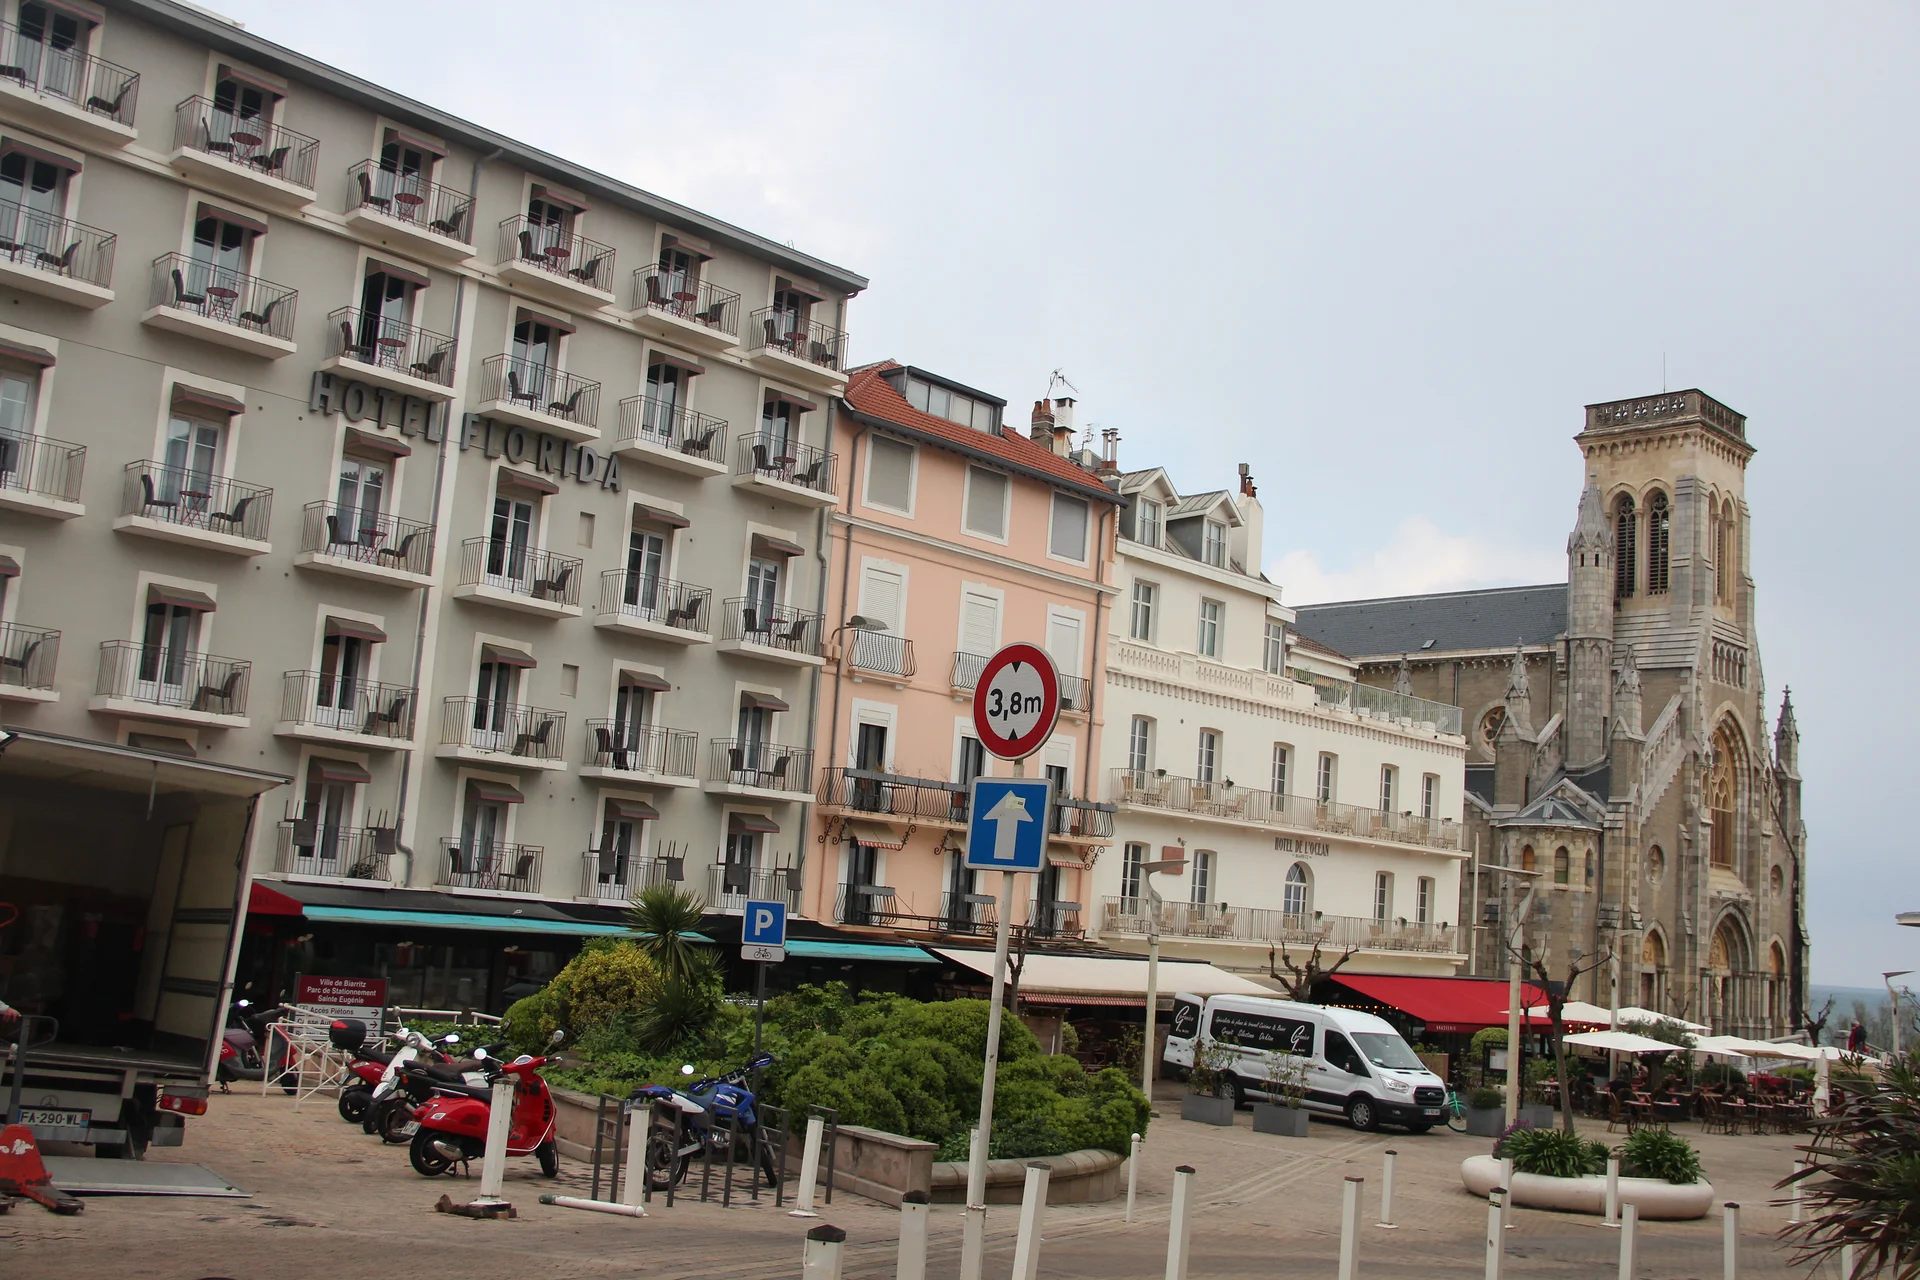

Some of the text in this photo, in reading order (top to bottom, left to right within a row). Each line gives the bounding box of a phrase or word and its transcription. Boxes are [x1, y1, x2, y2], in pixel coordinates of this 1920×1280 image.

[308, 371, 623, 493] HOTEL FLORIDA
[988, 688, 1042, 721] 3,8m
[1274, 836, 1293, 852] HOTEL
[1294, 839, 1303, 854] DE
[754, 908, 774, 936] P
[319, 978, 367, 988] Ville de Biarritz
[306, 986, 322, 994] Parc
[331, 987, 377, 997] Stationnement
[317, 994, 365, 1005] Sainte Eugénie
[310, 1006, 354, 1016] Accès Piétons
[20, 1111, 81, 1126] FA-290-WL
